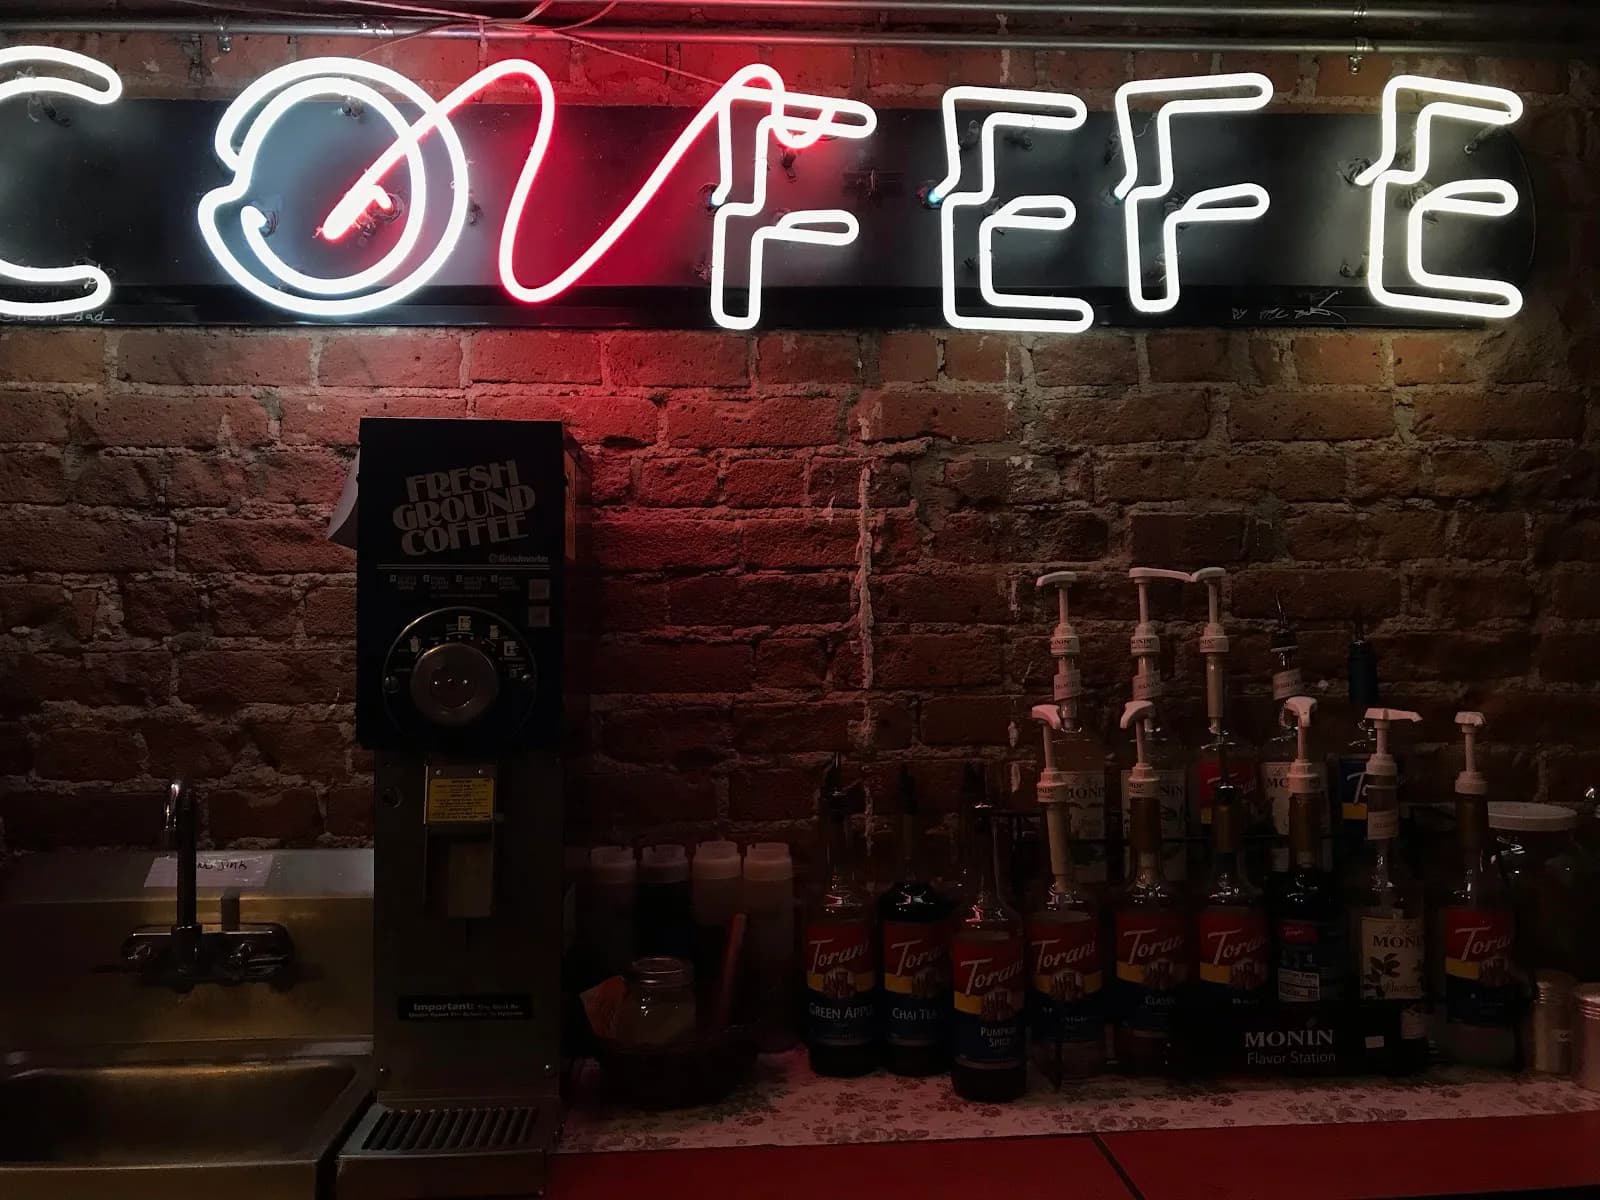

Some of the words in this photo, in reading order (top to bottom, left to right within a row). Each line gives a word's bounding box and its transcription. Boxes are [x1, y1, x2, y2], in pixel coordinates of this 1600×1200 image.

[405, 459, 520, 503] FRESH
[391, 484, 537, 532] GROUND
[400, 512, 530, 557] COFFEE
[1244, 1029, 1335, 1048] MONIN
[1246, 1050, 1286, 1065] Flavor
[1288, 1049, 1336, 1064] Station
